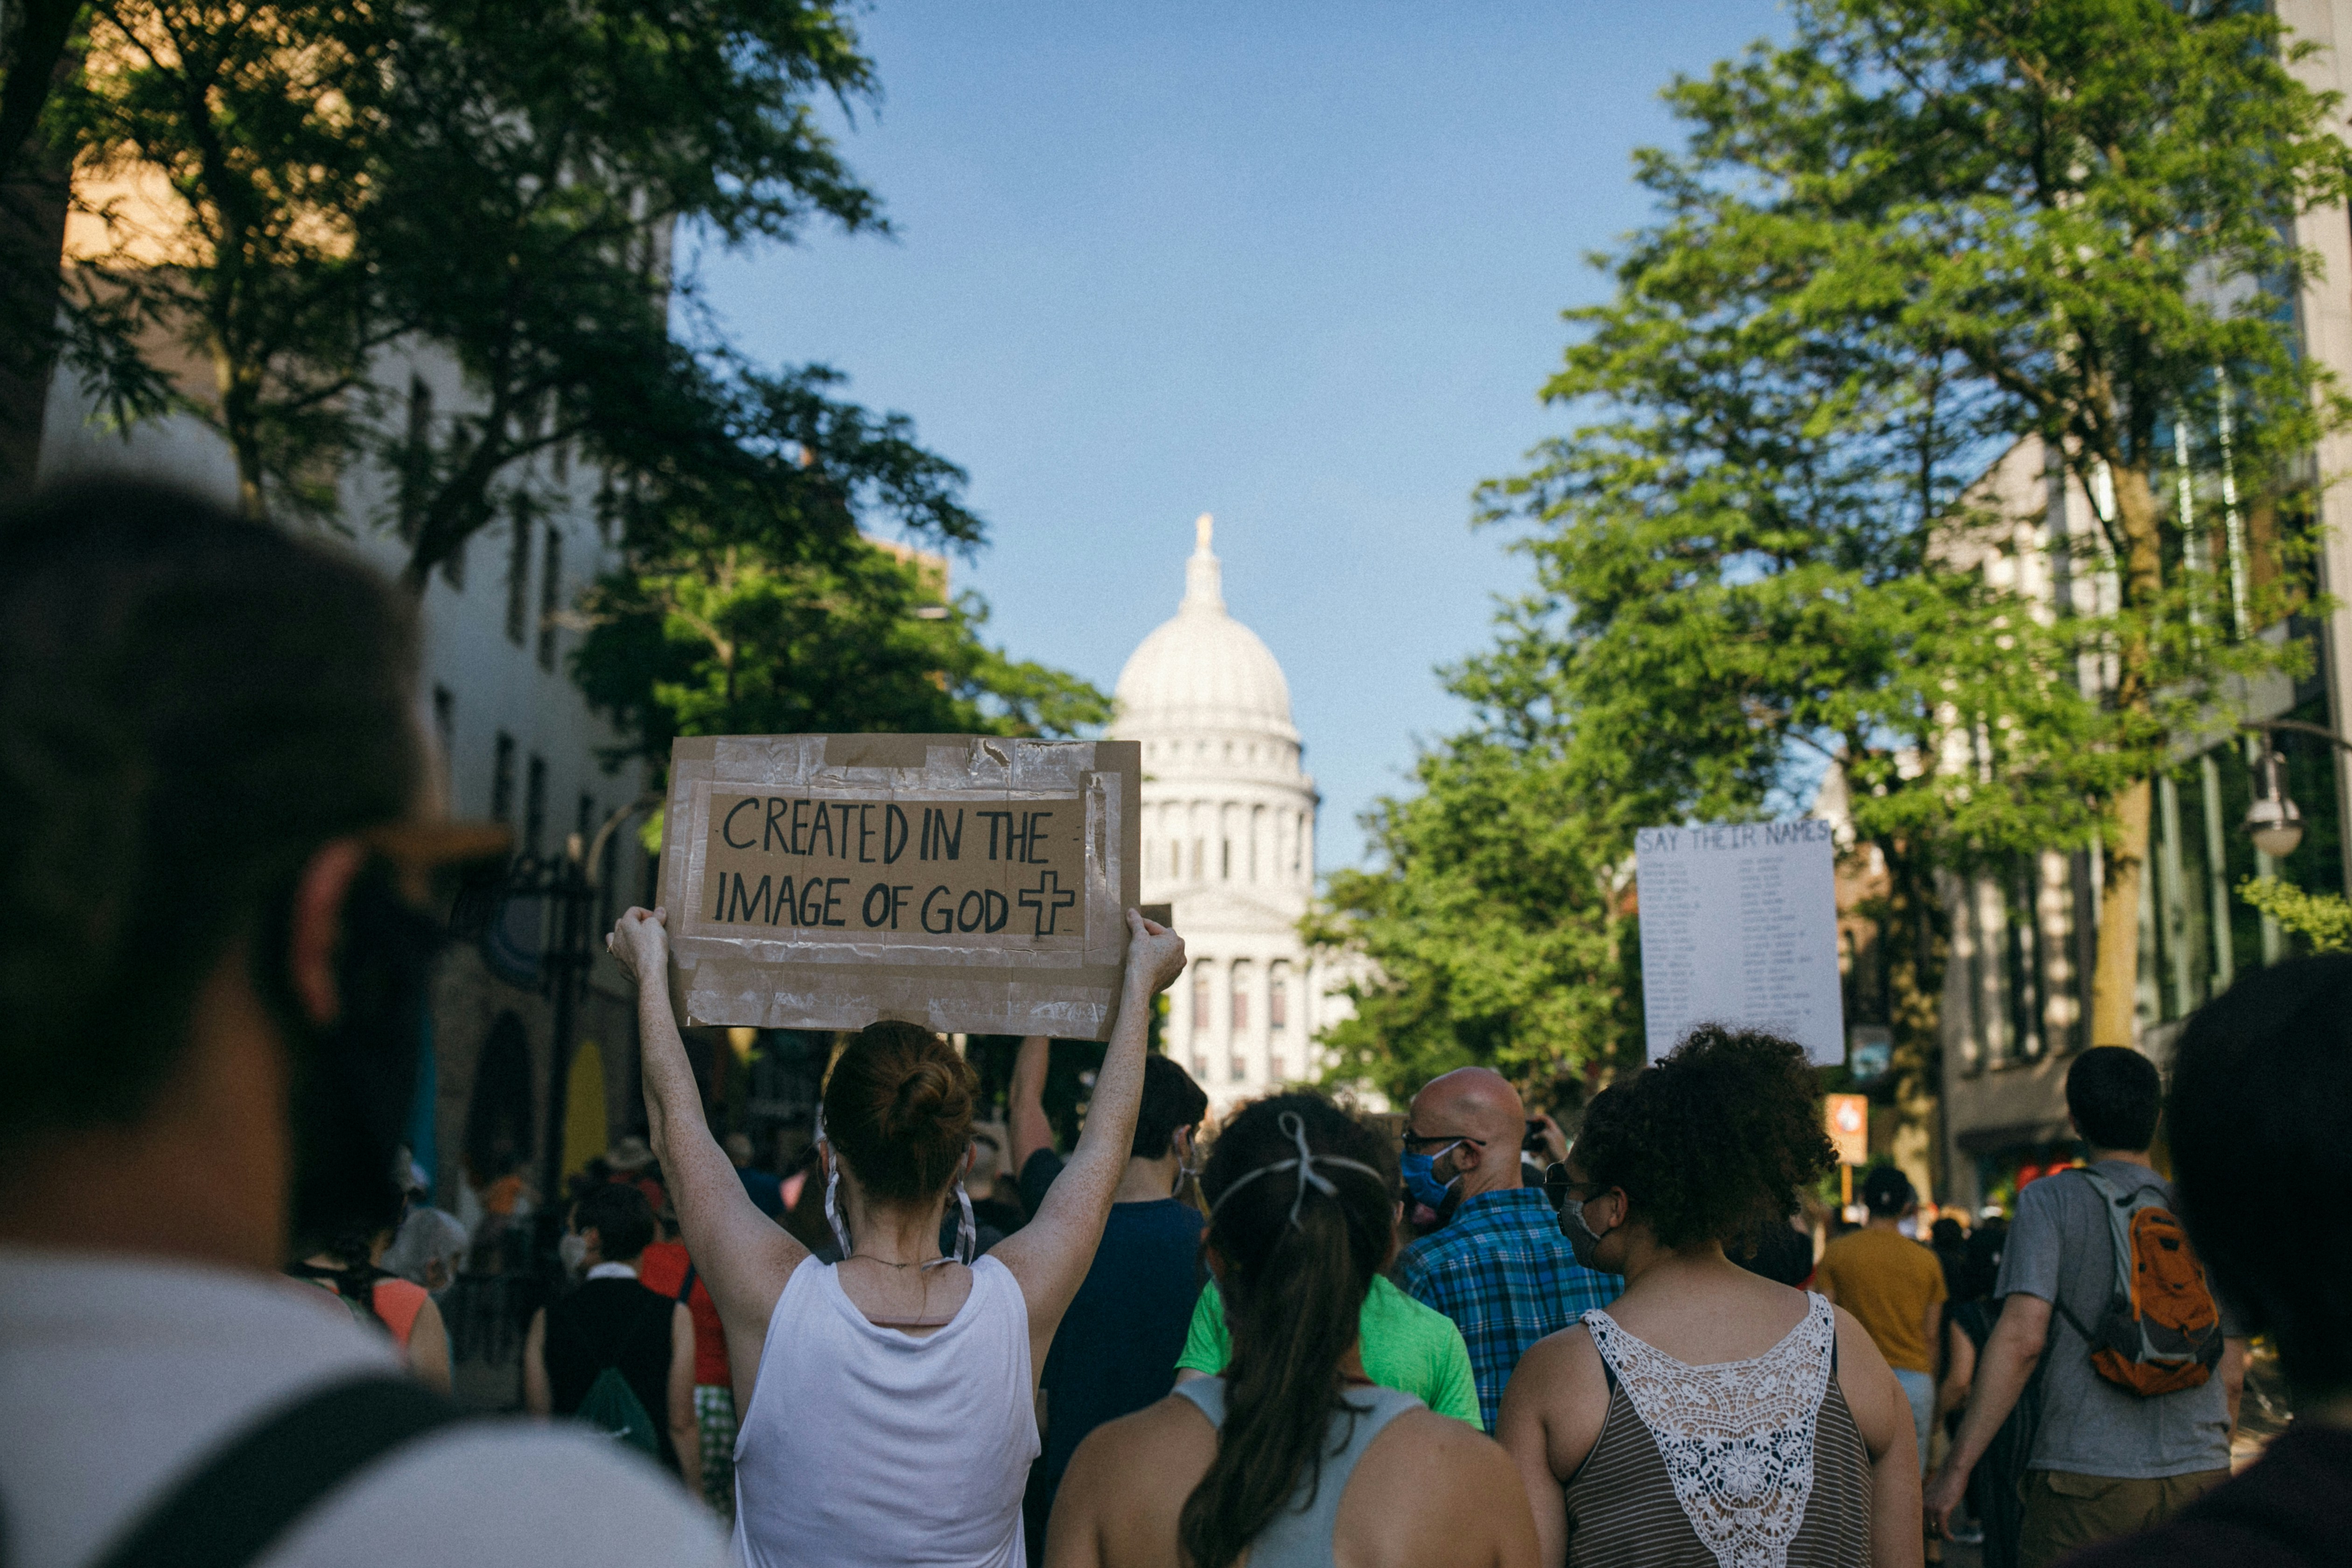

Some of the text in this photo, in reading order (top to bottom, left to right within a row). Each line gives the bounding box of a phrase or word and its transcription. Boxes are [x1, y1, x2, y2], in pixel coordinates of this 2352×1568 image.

[722, 797, 1053, 864] CREATED IN THE
[1638, 820, 1829, 854] SAY THEIR NAMES
[714, 872, 1009, 934] IMAGE OF GOD
